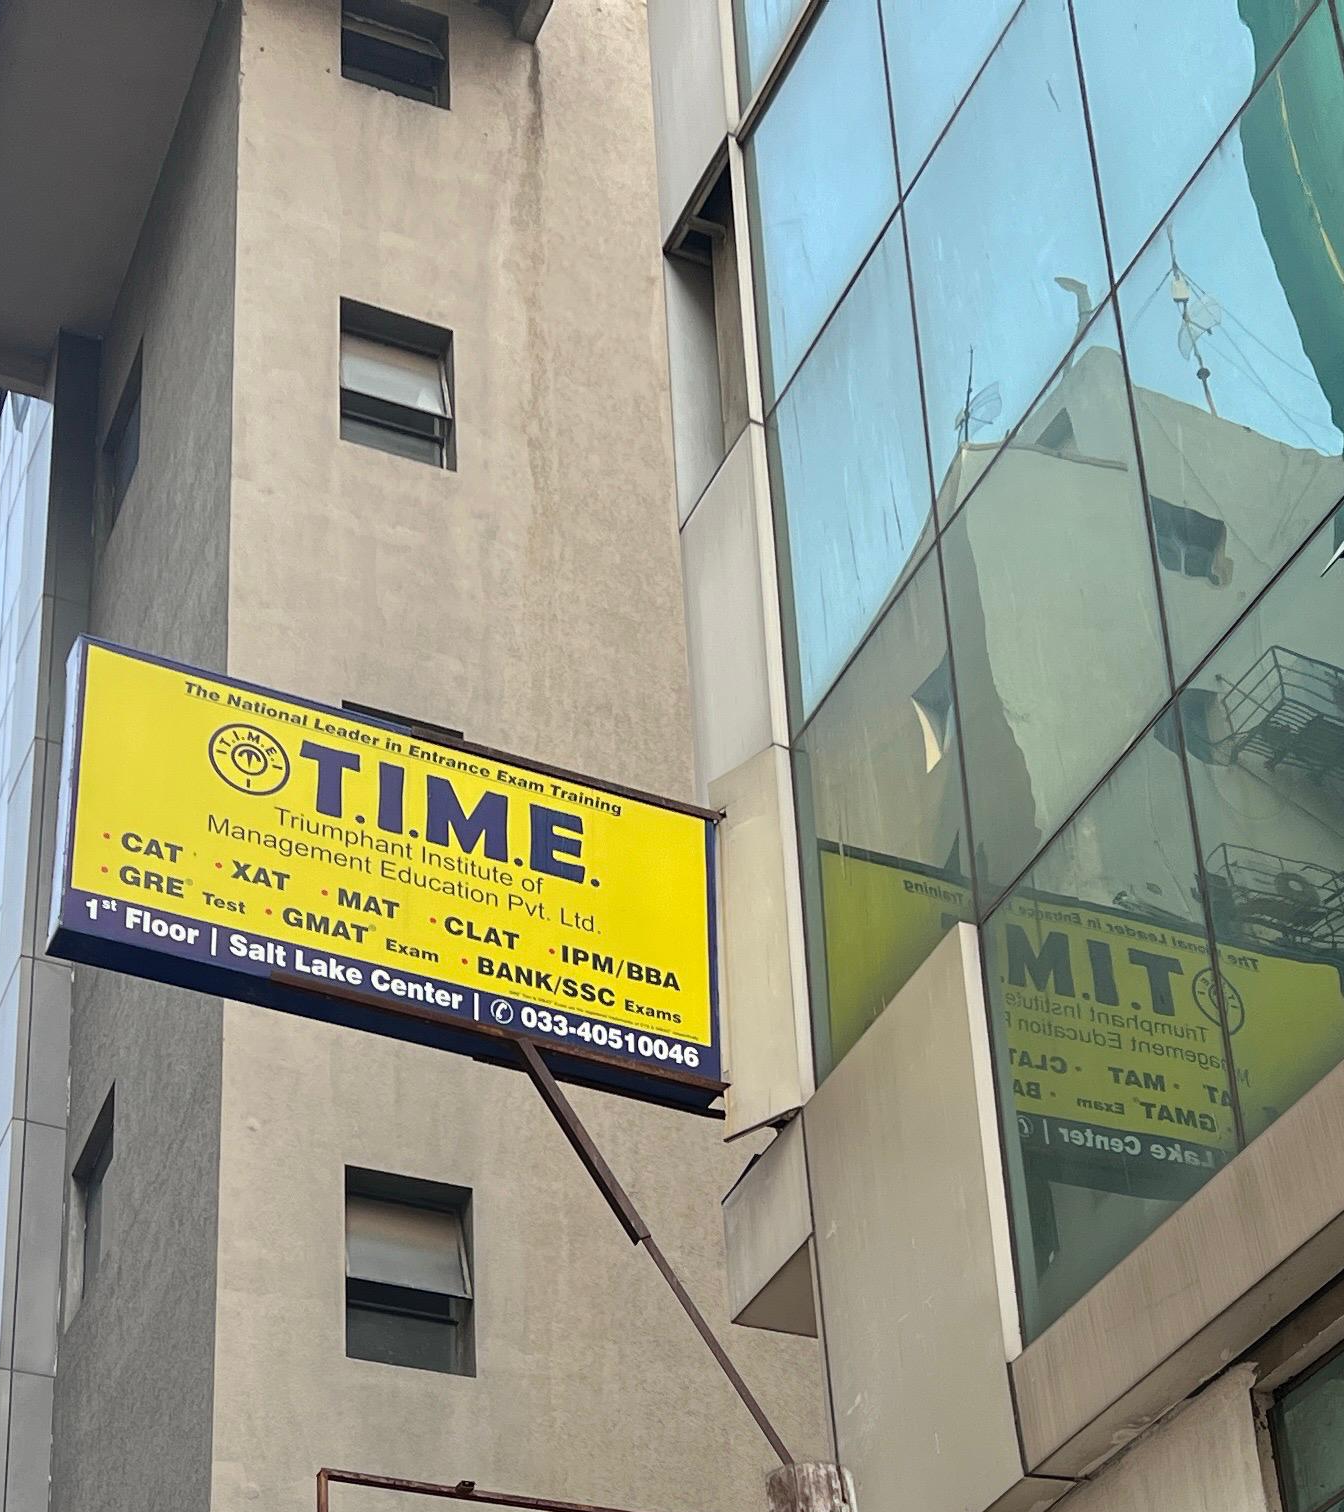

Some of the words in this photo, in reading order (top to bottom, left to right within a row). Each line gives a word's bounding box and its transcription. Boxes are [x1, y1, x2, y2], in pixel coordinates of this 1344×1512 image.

[185, 681, 220, 702] The
[227, 689, 308, 727] National
[314, 717, 380, 748] Leader
[385, 737, 402, 754] in
[408, 744, 491, 778] Entrance
[497, 769, 544, 794] Exam
[550, 784, 622, 816] Training
[121, 831, 184, 863] CAT
[231, 860, 290, 891] XAT
[338, 887, 400, 918] MAT
[444, 916, 520, 950] CLAT
[561, 945, 681, 992] IPM/BBA
[208, 814, 371, 875] Management
[381, 860, 498, 908] Education
[508, 893, 551, 921] Pvt.
[560, 907, 602, 935] Ltd.
[274, 806, 413, 860] Triumphant
[422, 845, 513, 886] Institute
[522, 877, 544, 895] of
[85, 897, 117, 920] 1st
[125, 907, 200, 945] Floor
[229, 933, 287, 968] Salt
[295, 949, 363, 986] Lake
[370, 969, 464, 1010] Center
[520, 1006, 701, 1068] 033-40510046
[202, 891, 247, 915] Test
[385, 938, 439, 963] Exam
[478, 956, 615, 1007] BANK/SSC
[624, 999, 682, 1024] Exams
